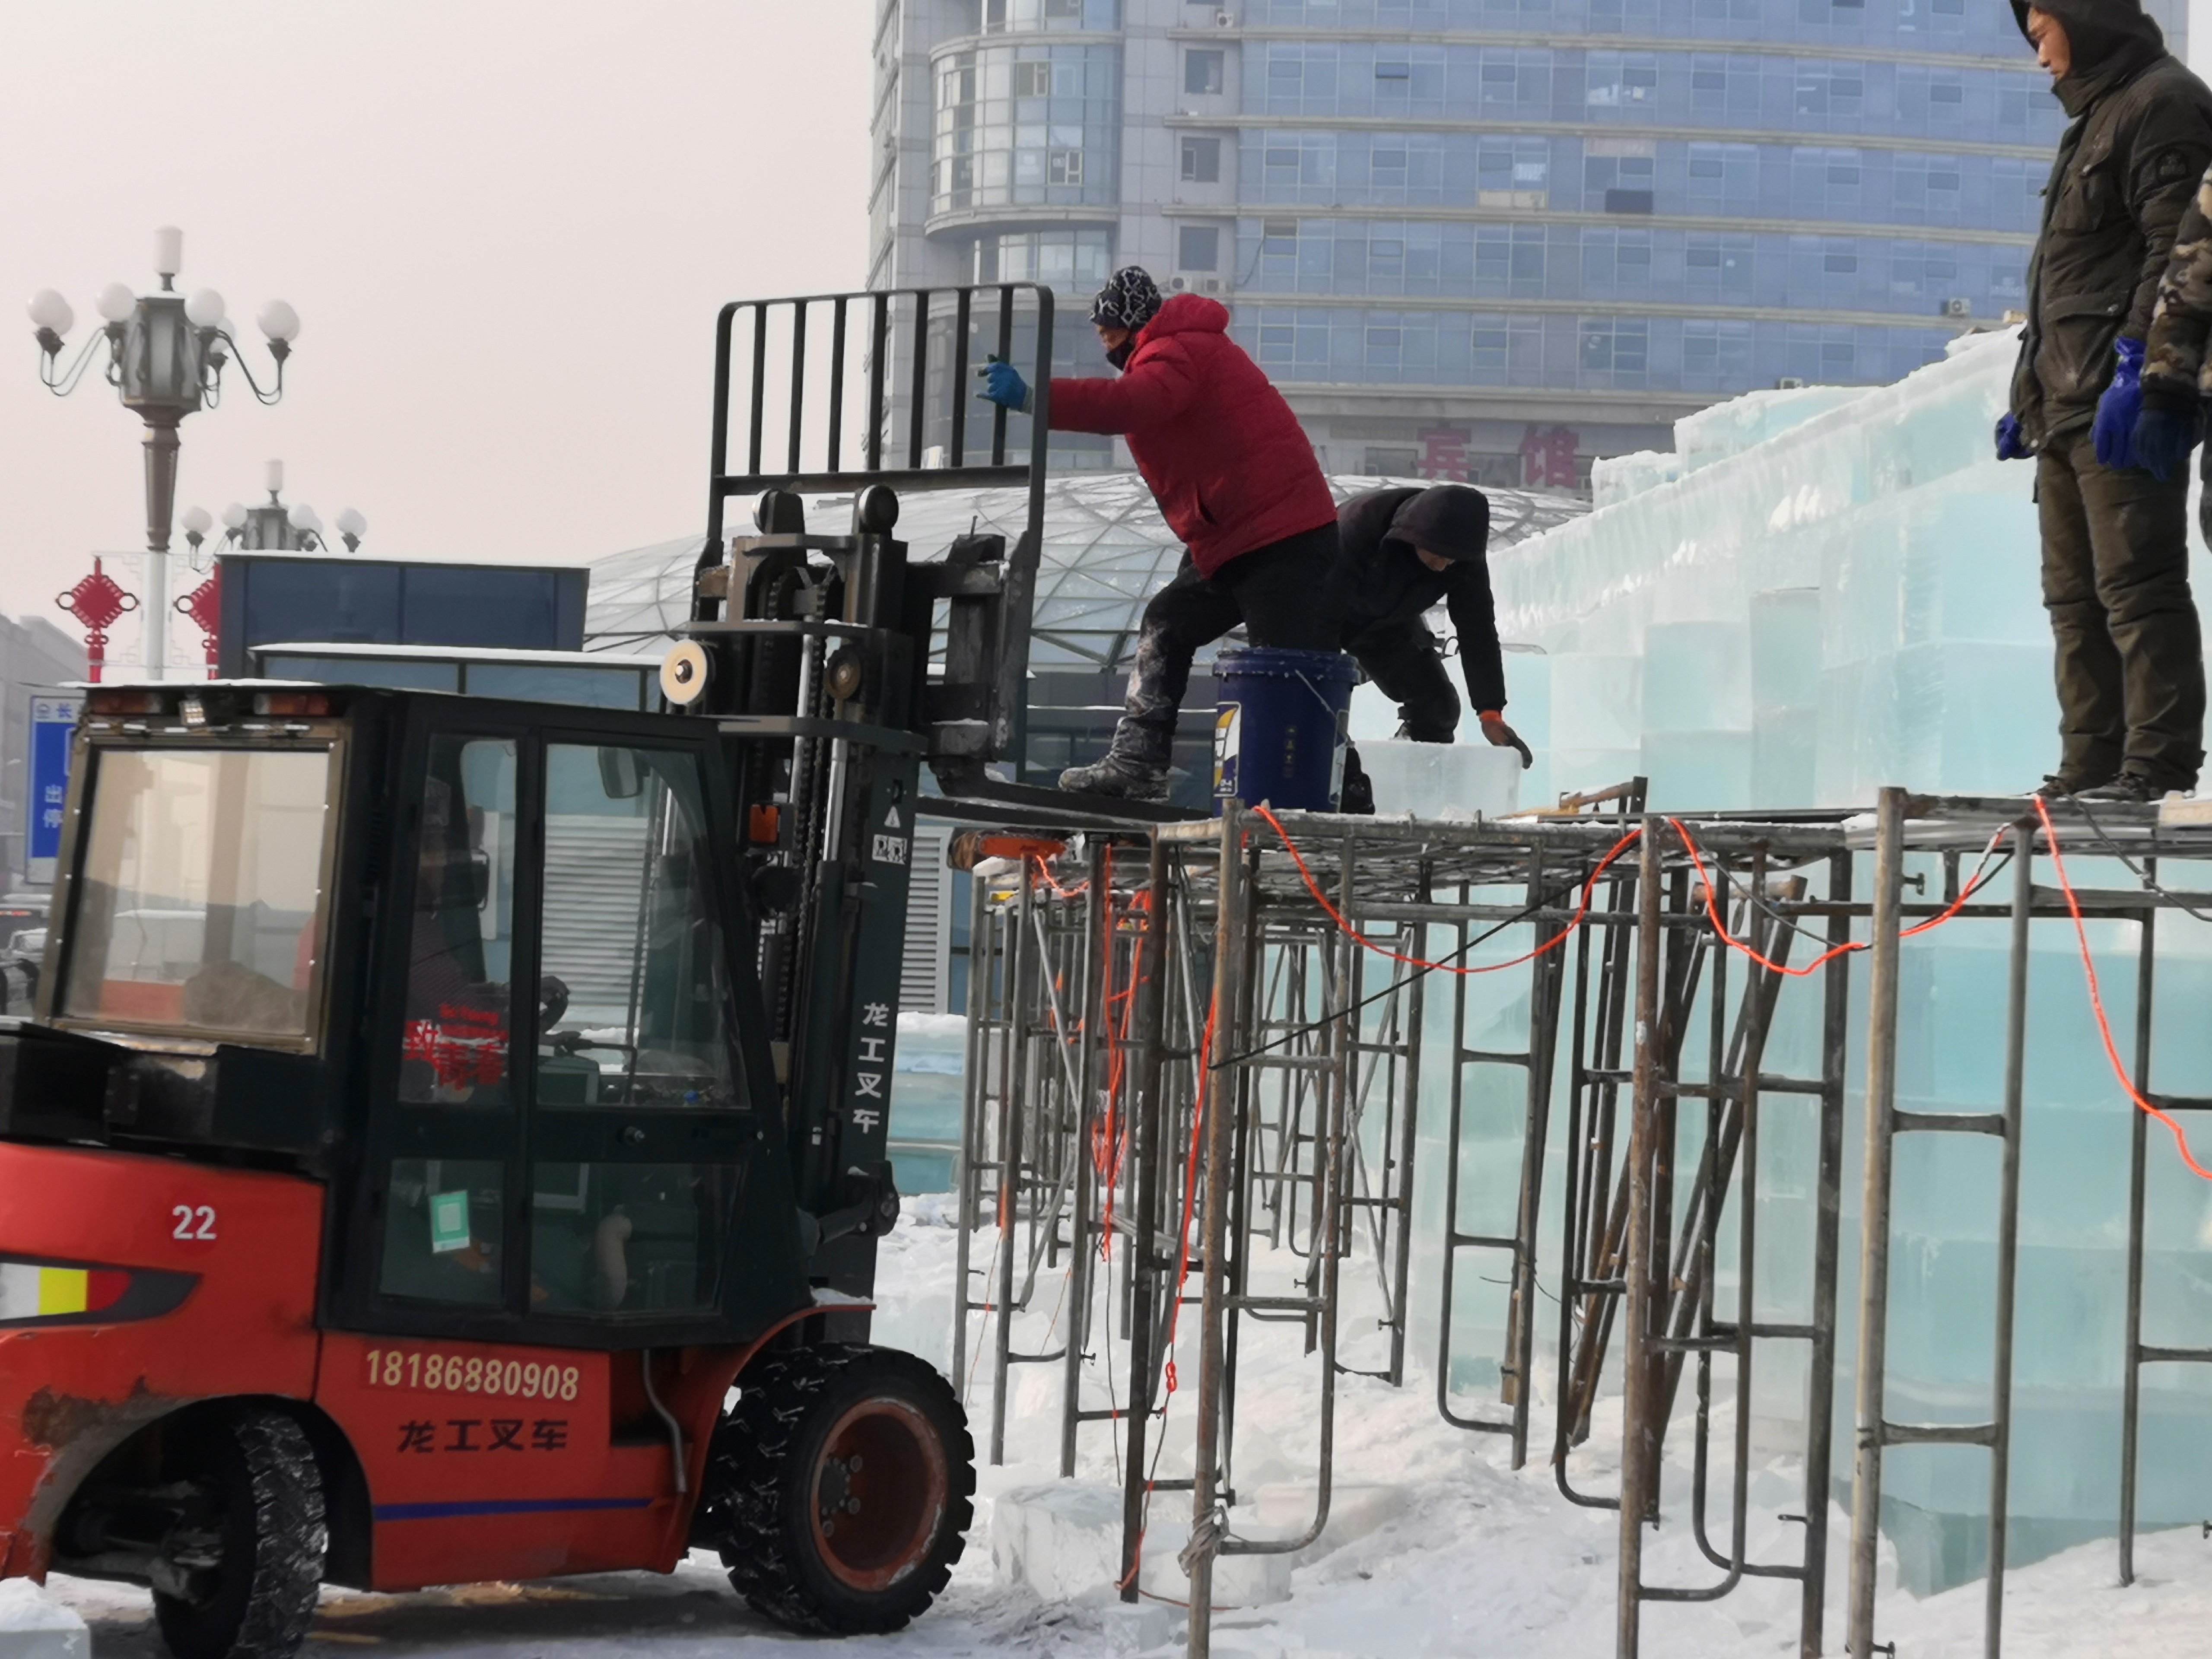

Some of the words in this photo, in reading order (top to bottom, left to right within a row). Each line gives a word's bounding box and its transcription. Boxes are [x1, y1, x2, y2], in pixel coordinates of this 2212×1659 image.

[852, 1001, 890, 1135] 龙工叉车
[172, 1205, 217, 1240] 22
[366, 1350, 580, 1401] 18186880908
[397, 1419, 569, 1453] 龙工叉车
